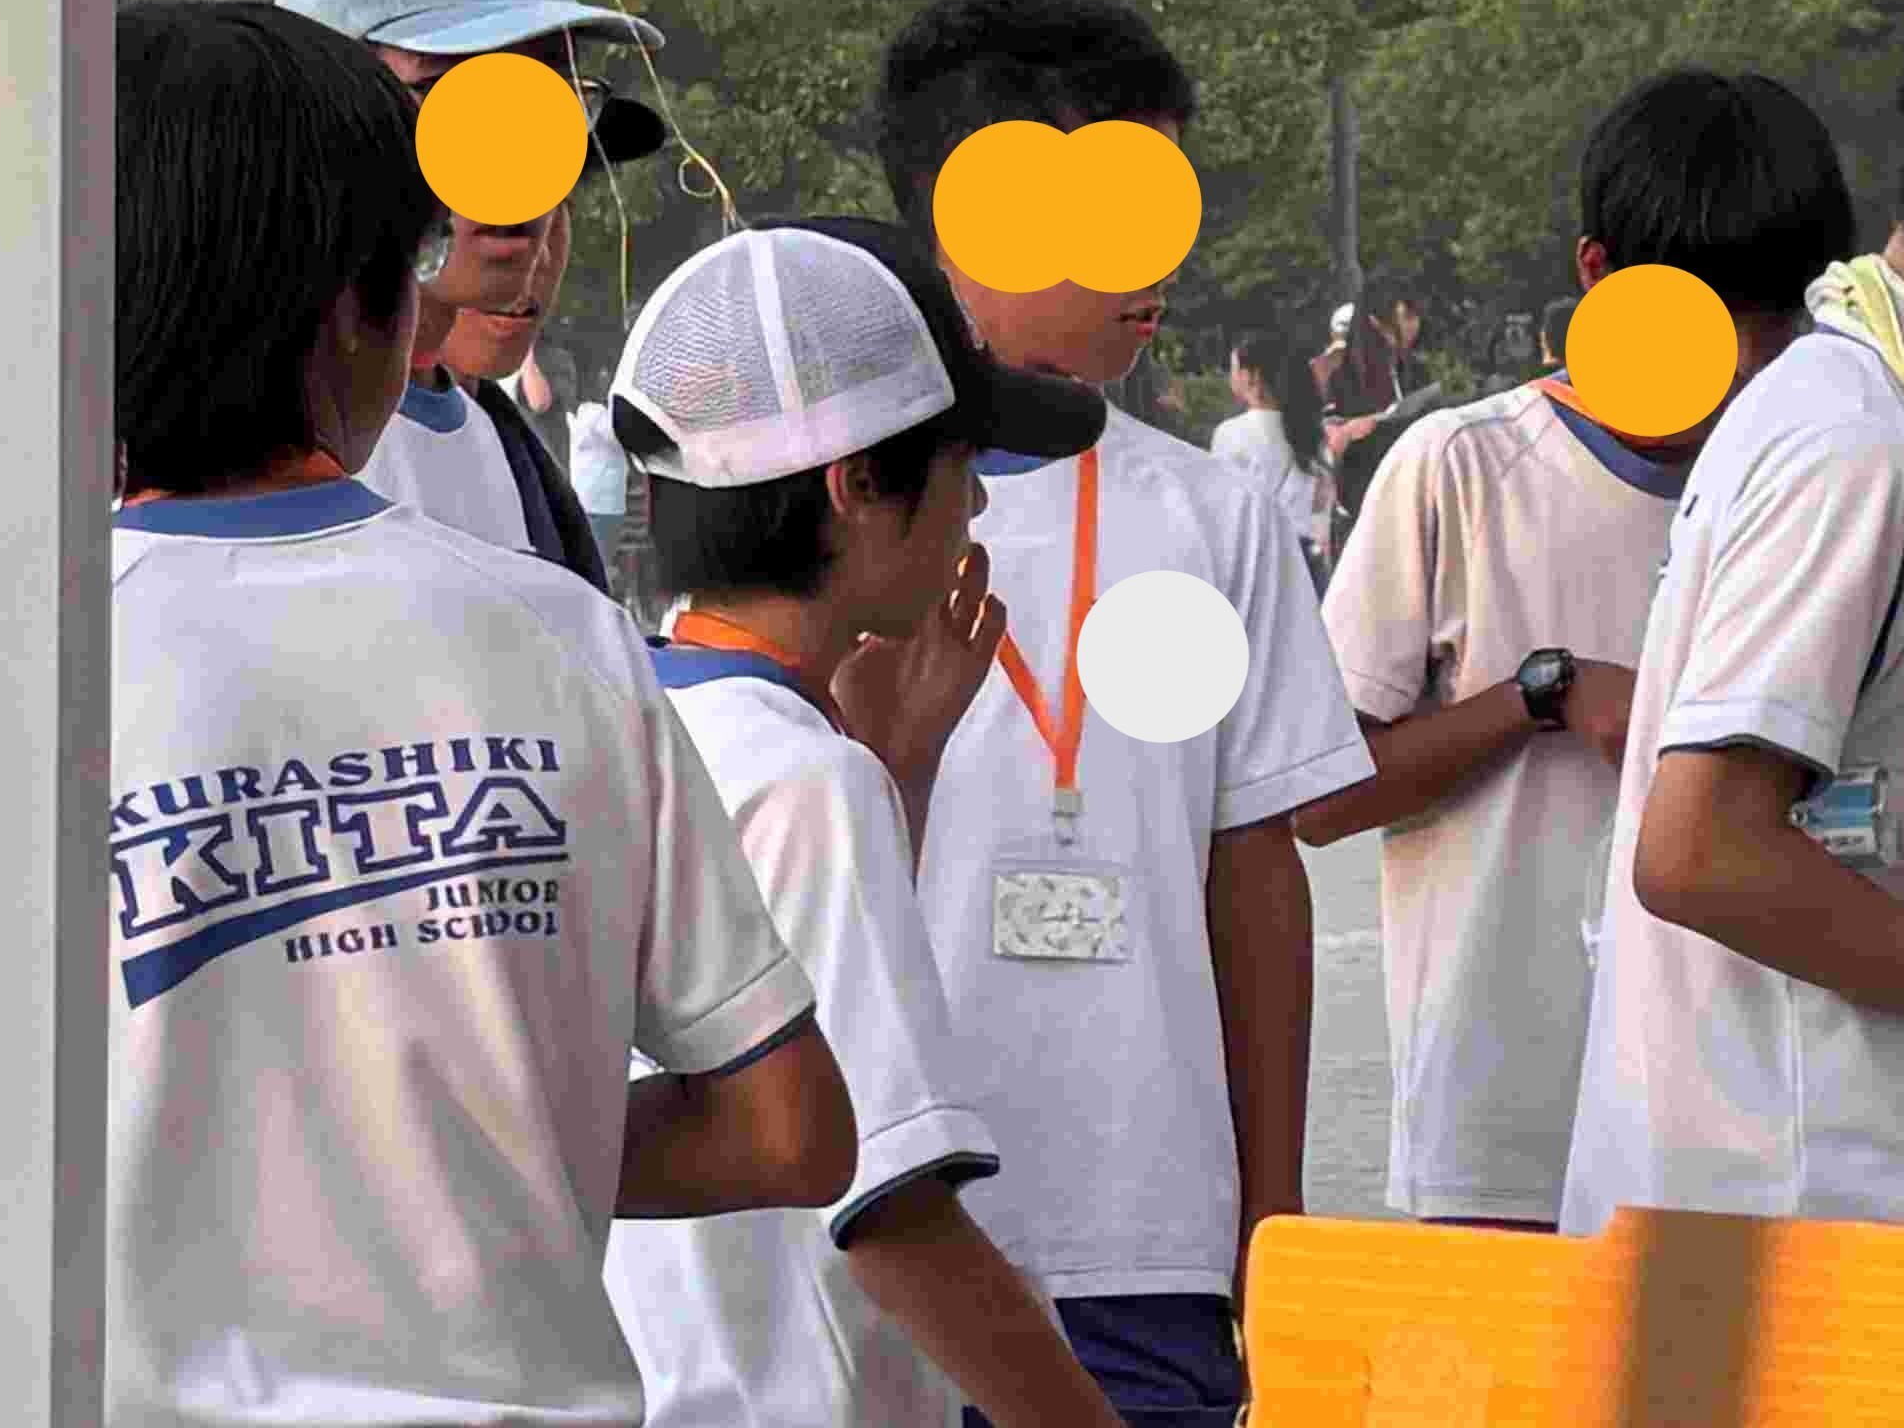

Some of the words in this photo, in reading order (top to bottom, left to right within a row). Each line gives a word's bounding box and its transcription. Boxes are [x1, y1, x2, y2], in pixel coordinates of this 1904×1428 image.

[109, 736, 561, 836] KURASHIKI
[109, 776, 567, 941] KITA
[426, 879, 560, 913] JUNIOR
[285, 923, 398, 963] HIGH
